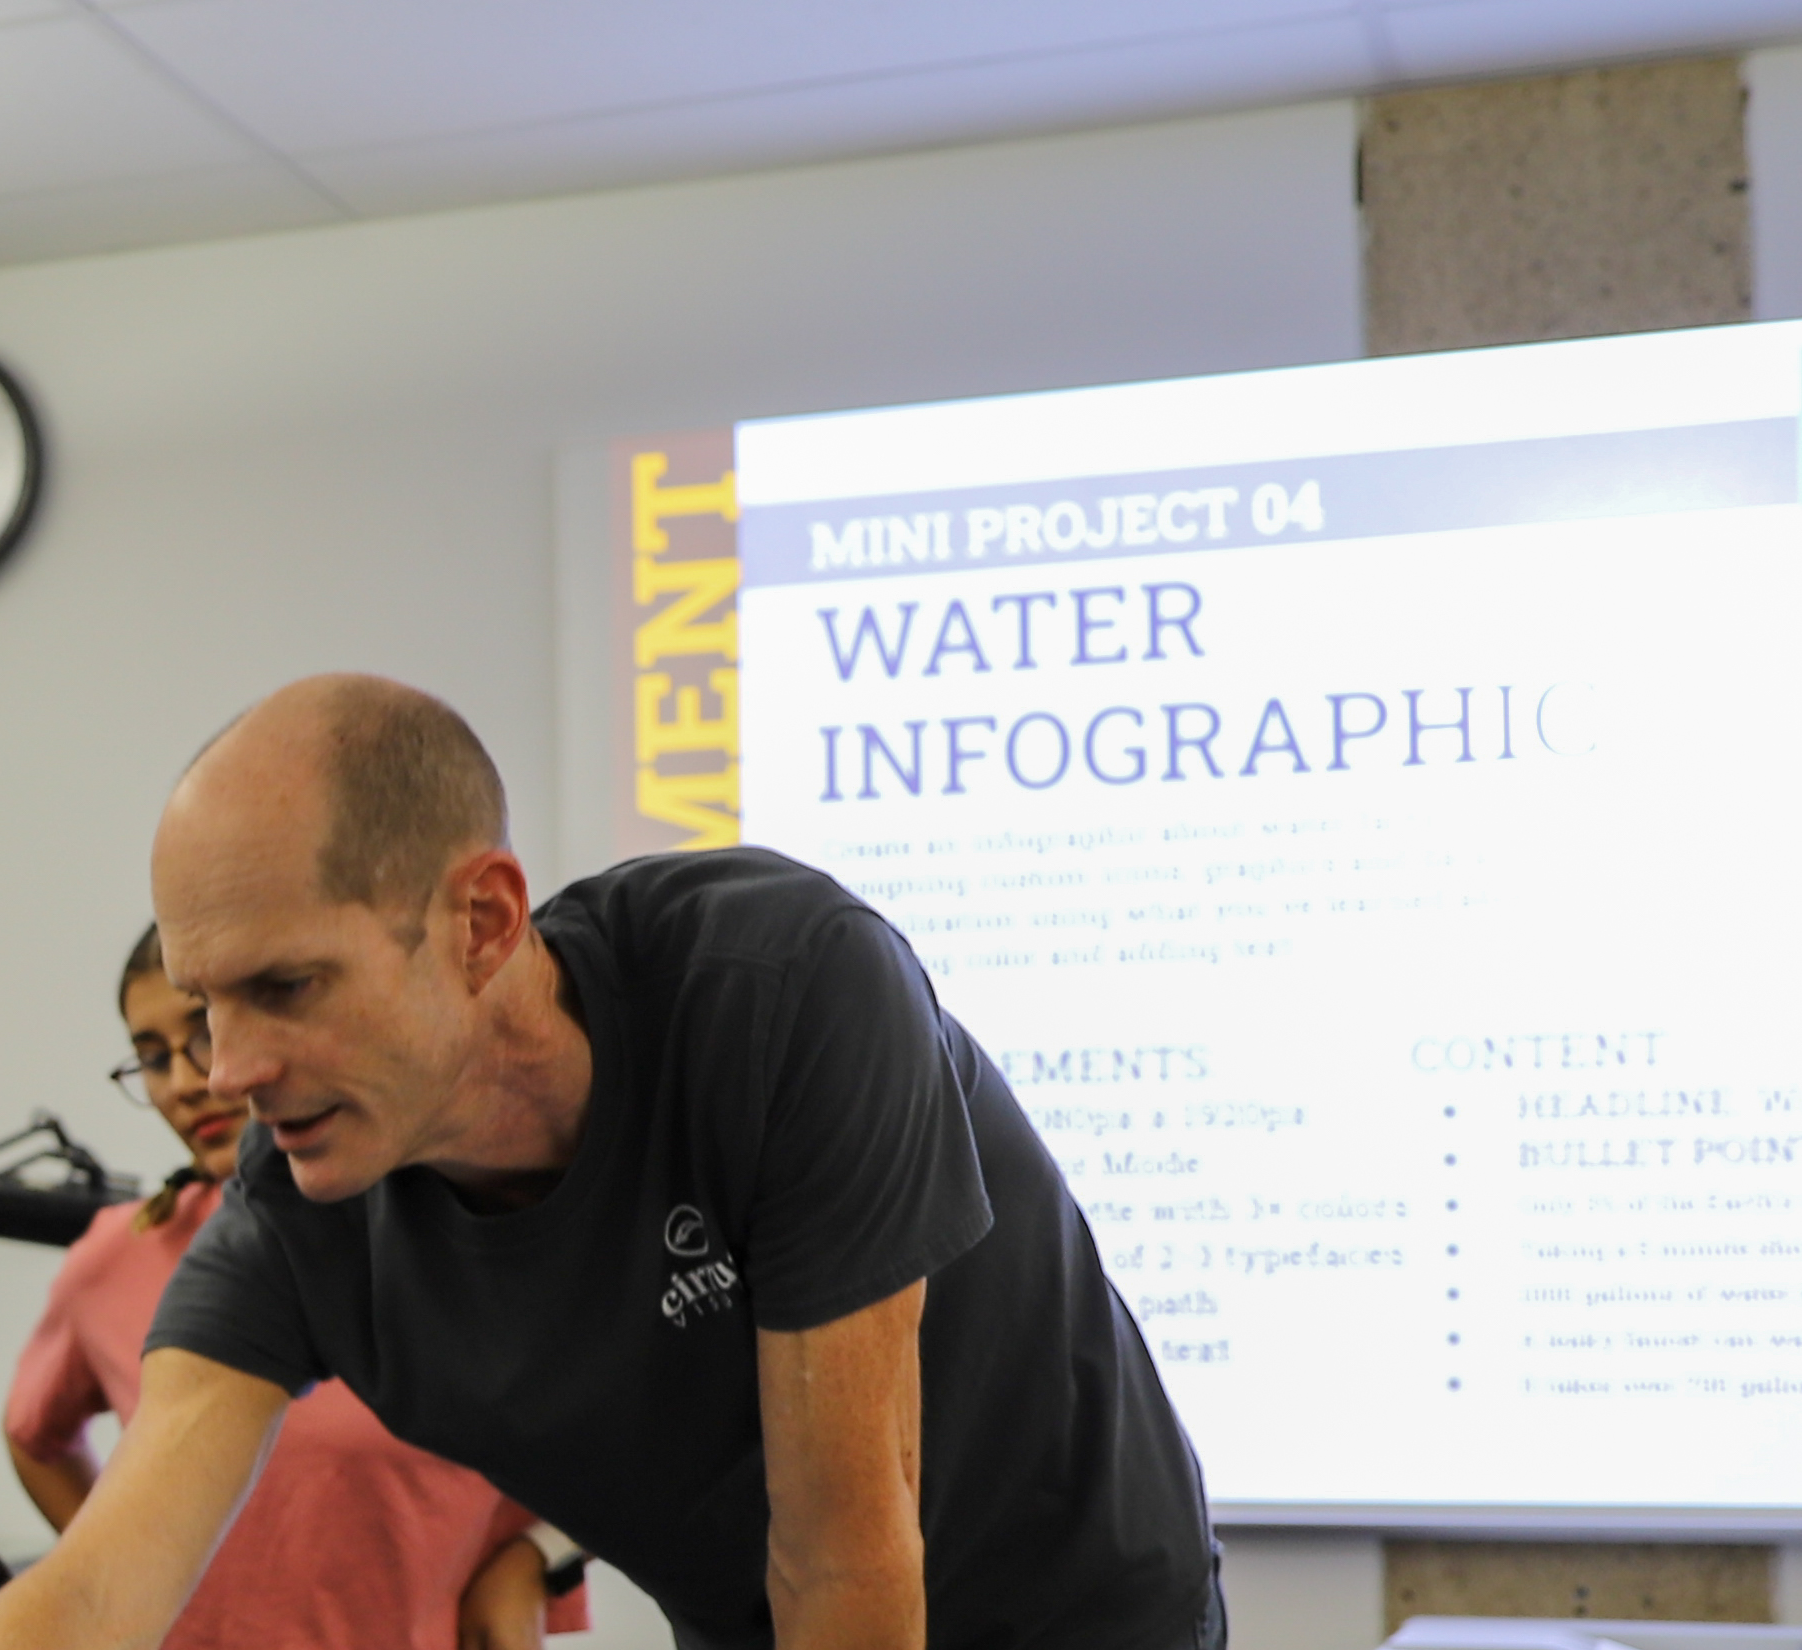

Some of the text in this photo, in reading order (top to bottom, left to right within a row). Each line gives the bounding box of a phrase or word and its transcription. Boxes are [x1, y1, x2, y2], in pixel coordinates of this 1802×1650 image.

[809, 481, 1325, 571] MINI PROJECT 04
[814, 581, 1208, 683] WATER
[1410, 1027, 1668, 1073] CONTENT
[1517, 1085, 1739, 1121] HEADLINE
[1518, 1135, 1679, 1170] BULLET
